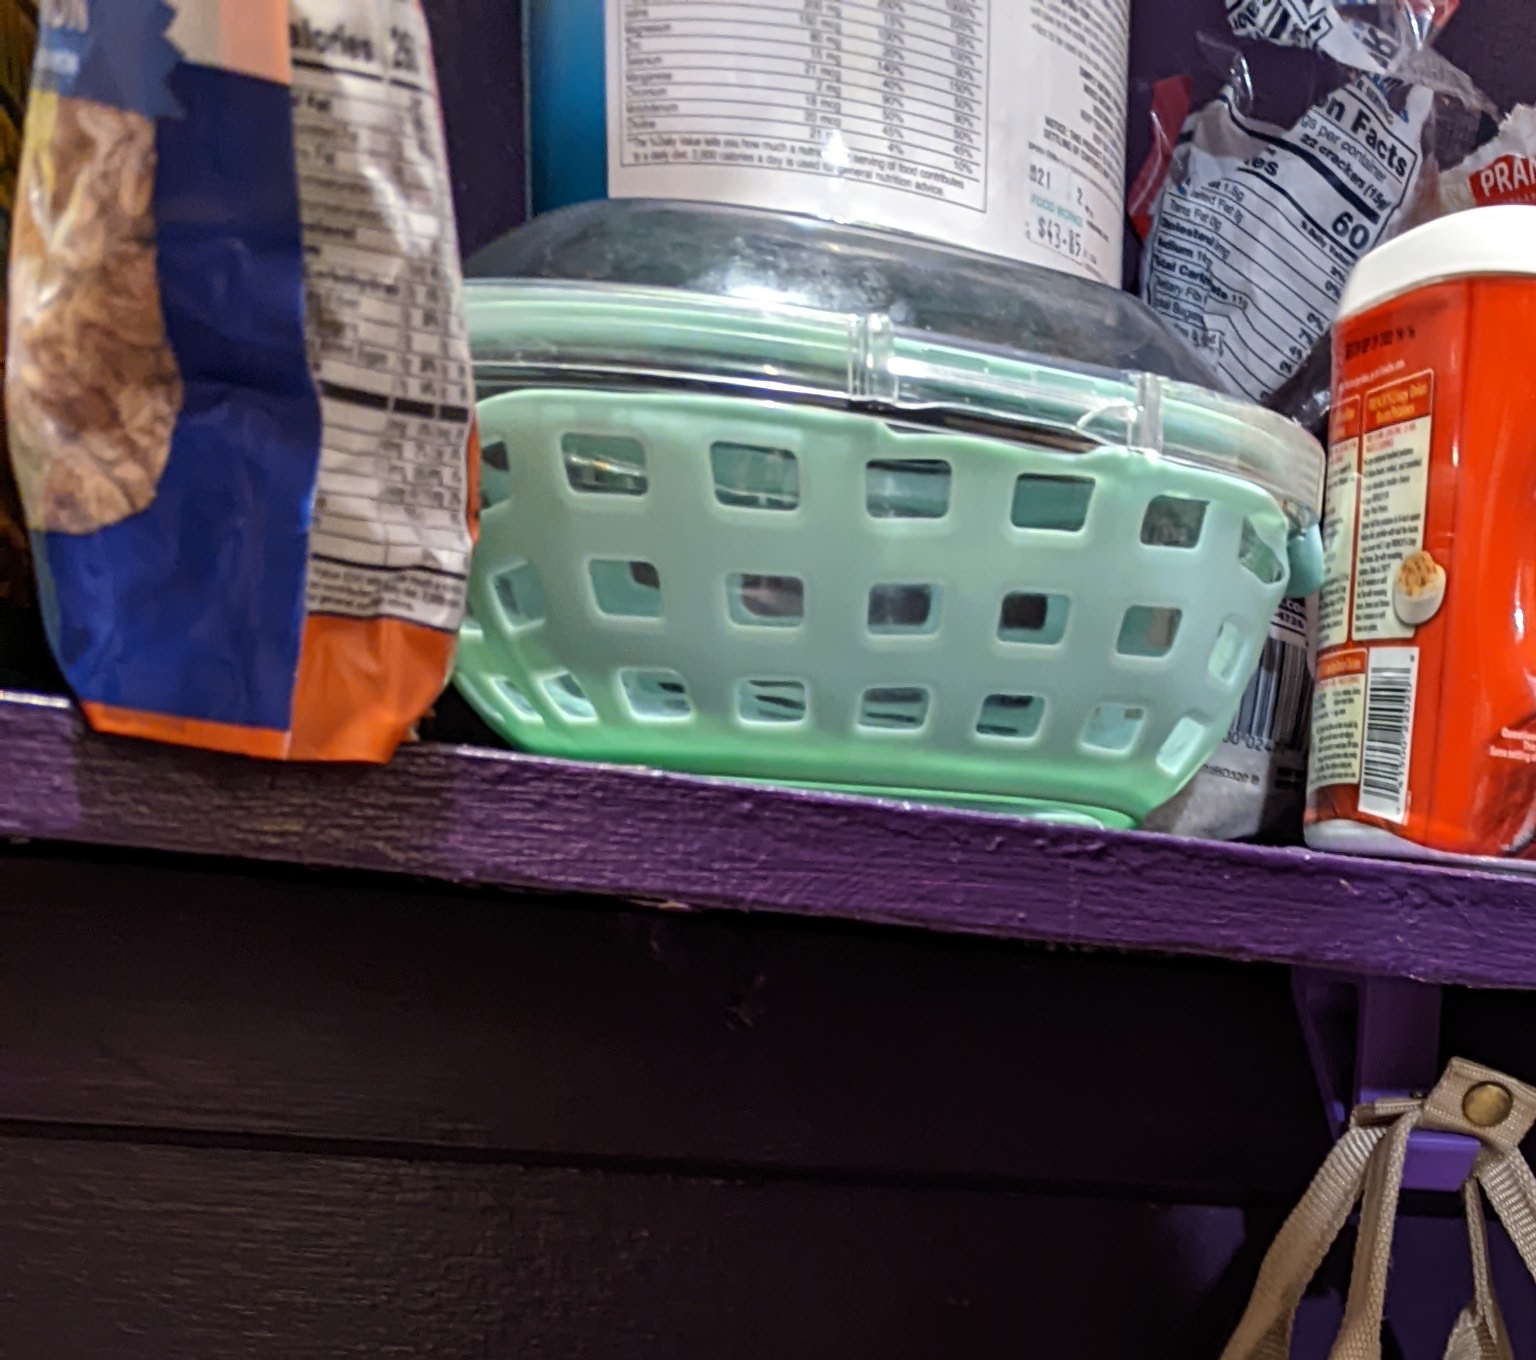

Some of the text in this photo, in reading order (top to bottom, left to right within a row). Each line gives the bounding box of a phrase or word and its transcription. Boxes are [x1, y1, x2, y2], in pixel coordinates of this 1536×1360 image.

[1350, 108, 1409, 178] Facts
[1318, 145, 1366, 190] crackers
[1331, 210, 1371, 250] 60
